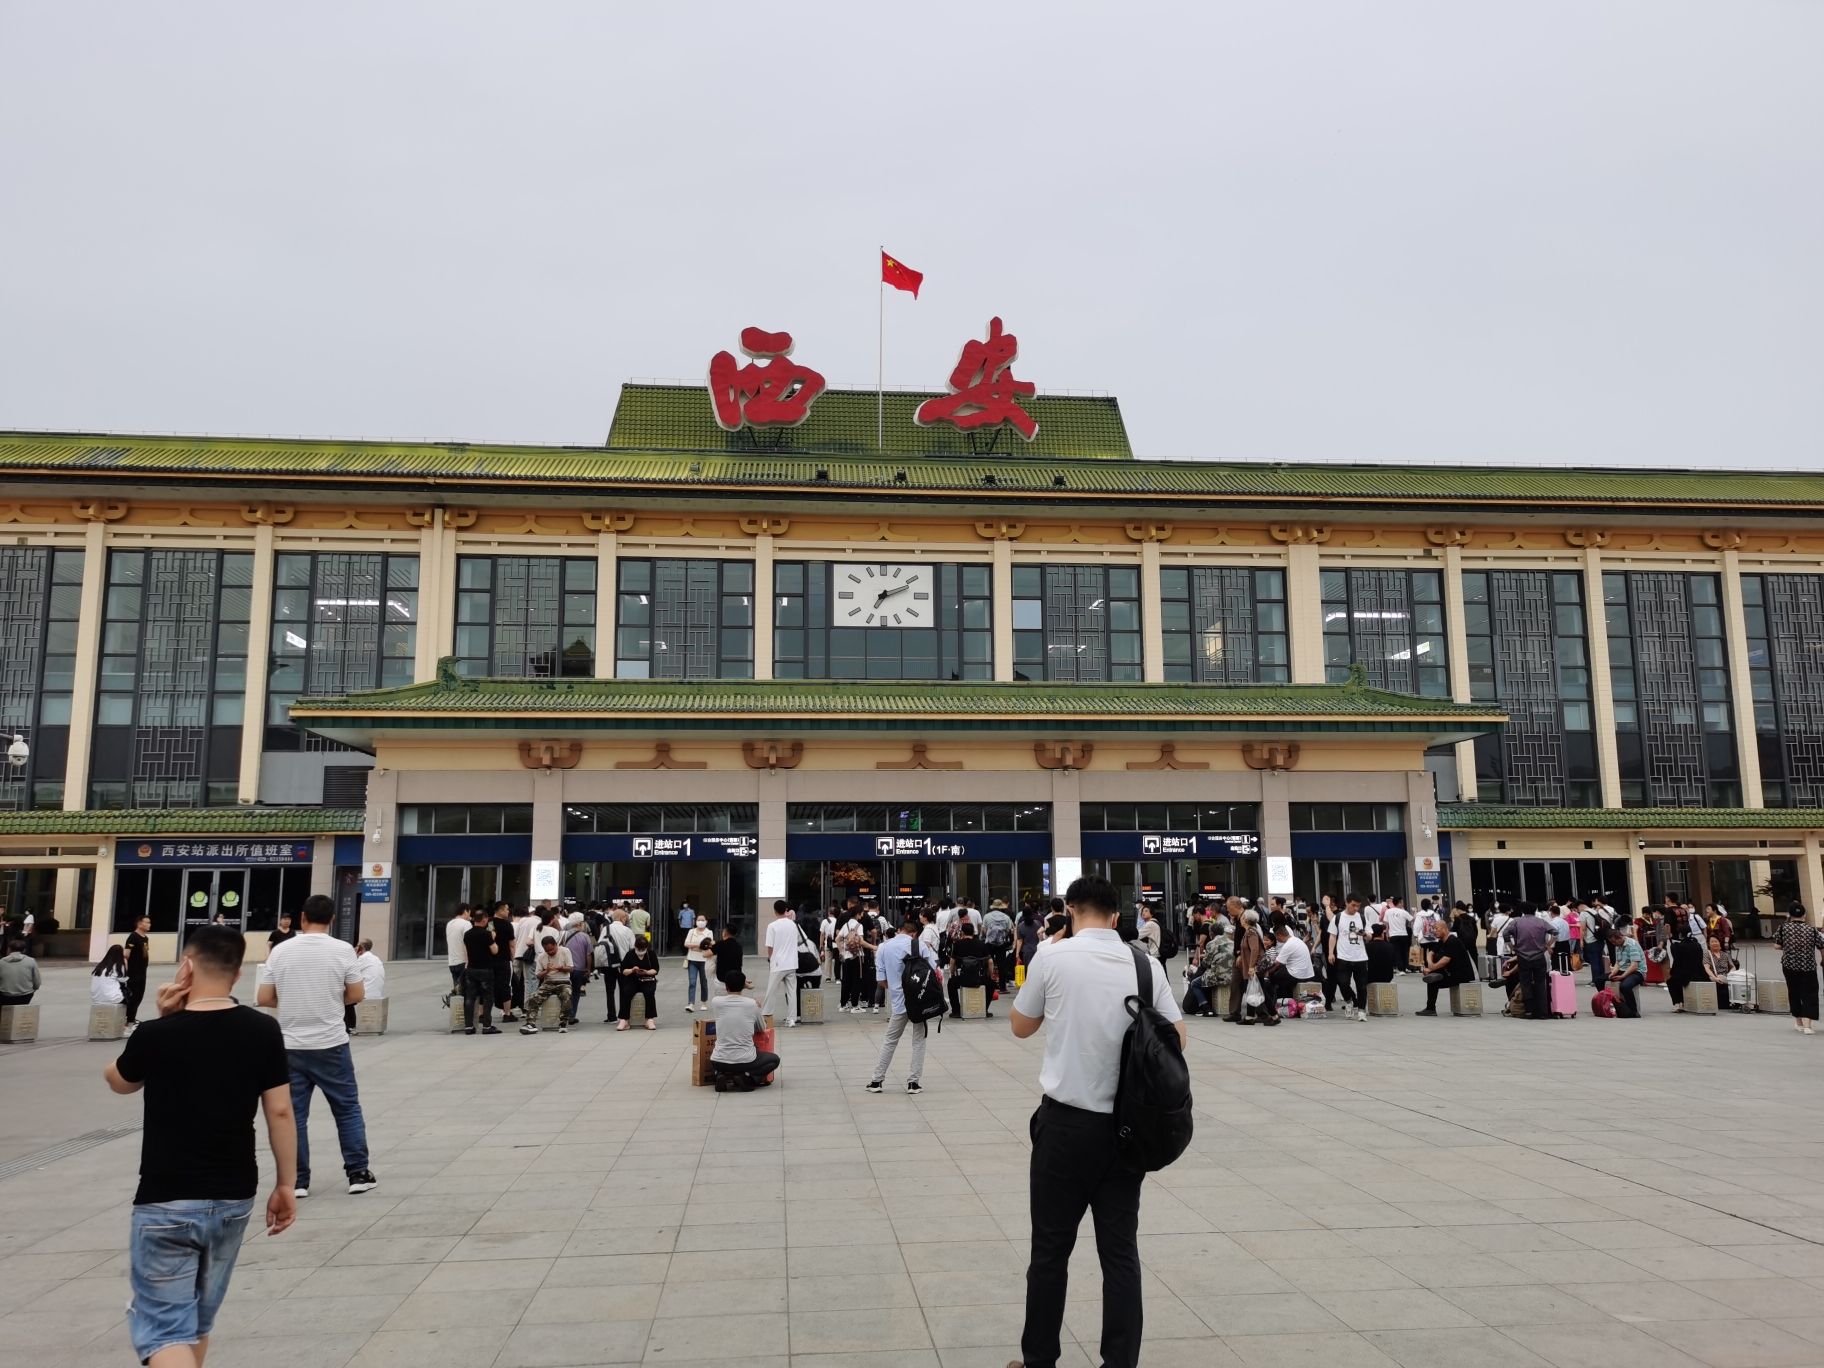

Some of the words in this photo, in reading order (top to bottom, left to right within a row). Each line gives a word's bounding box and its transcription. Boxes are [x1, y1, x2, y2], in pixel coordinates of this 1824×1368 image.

[708, 316, 1039, 442] 西安
[161, 844, 293, 857] 西安站派出所值班室
[654, 839, 682, 849] 进站口
[683, 838, 691, 857] 1
[896, 838, 923, 848] 进站口
[923, 837, 932, 856] 1
[1162, 837, 1188, 847] 进站口
[1188, 836, 1197, 854] 1
